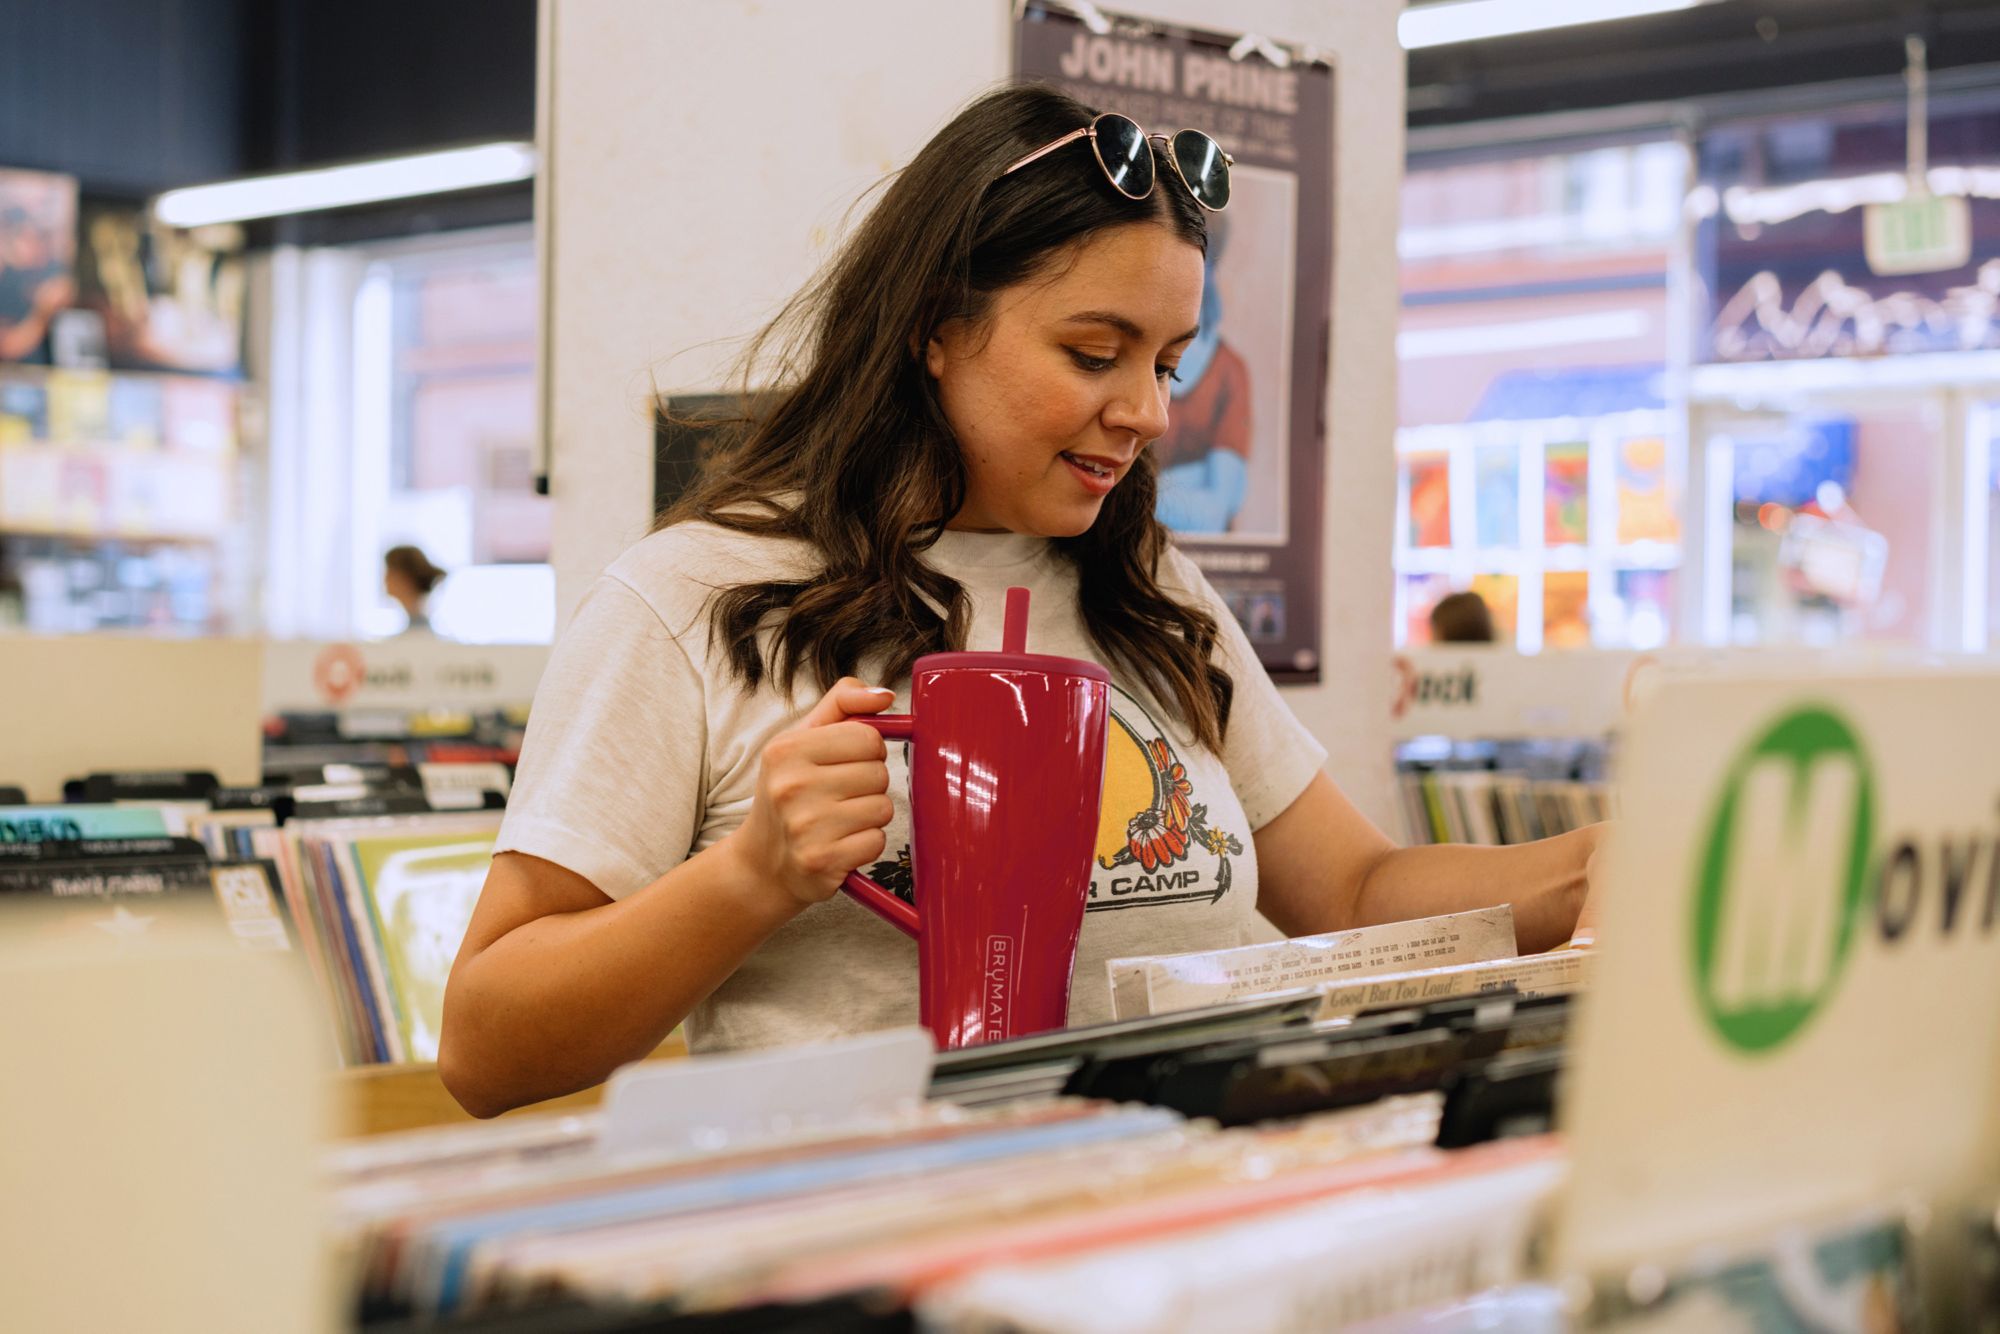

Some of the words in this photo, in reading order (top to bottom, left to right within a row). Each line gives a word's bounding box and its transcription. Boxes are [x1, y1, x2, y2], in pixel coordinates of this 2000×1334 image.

[1060, 33, 1175, 93] JOHN
[1182, 53, 1298, 115] PRINE
[1111, 870, 1200, 895] CAMP
[987, 940, 1008, 1041] BRÜMATE
[1330, 987, 1366, 1008] Good
[1369, 984, 1392, 1003] But
[1394, 981, 1418, 1001] Too
[1422, 976, 1455, 997] Loud
